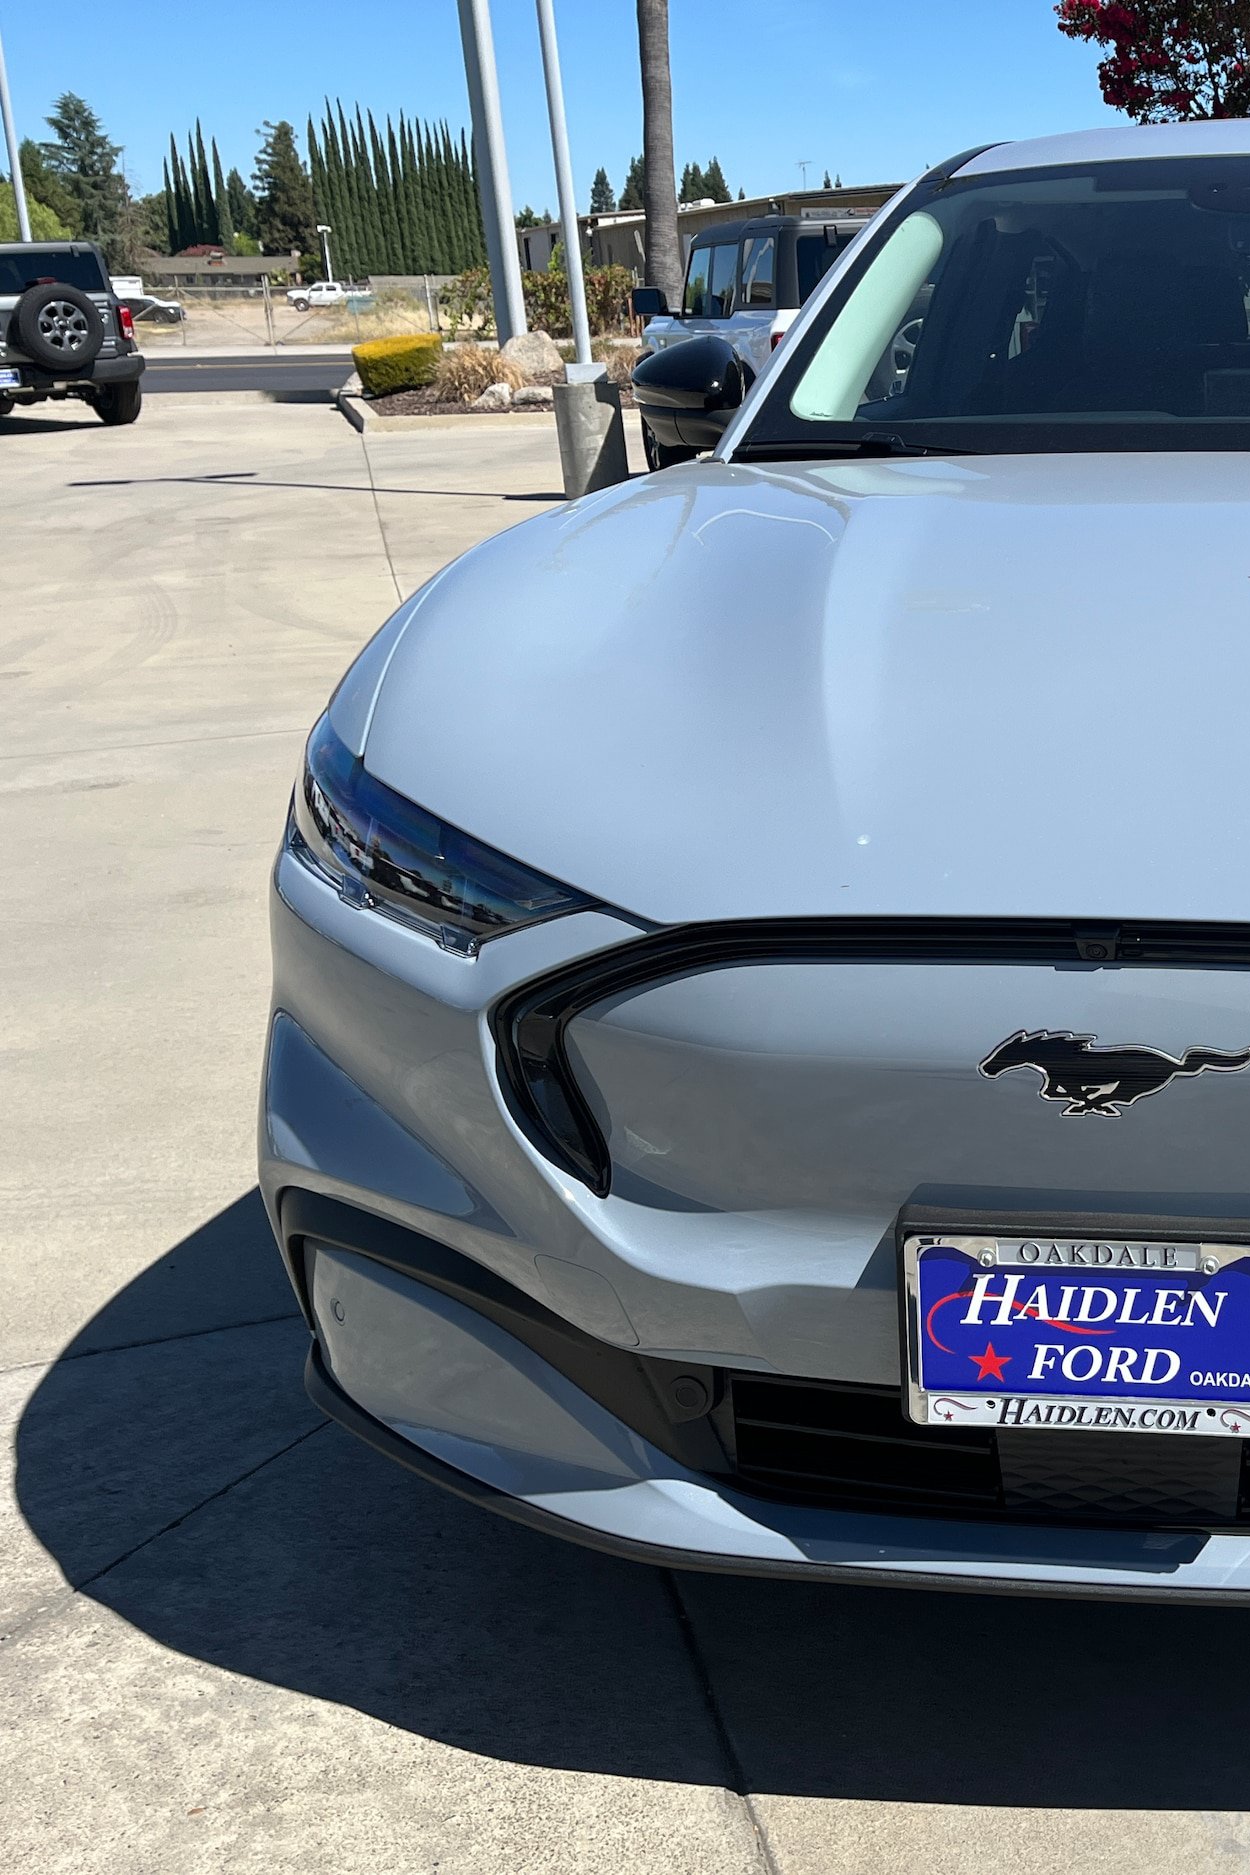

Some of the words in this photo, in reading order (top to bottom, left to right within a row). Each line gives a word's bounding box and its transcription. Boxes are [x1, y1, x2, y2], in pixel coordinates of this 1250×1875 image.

[1019, 1241, 1179, 1268] OAKDALE
[959, 1273, 1229, 1328] HAIDLEN
[1027, 1343, 1181, 1385] FORD
[996, 1398, 1201, 1431] HAIDLEN.COM
